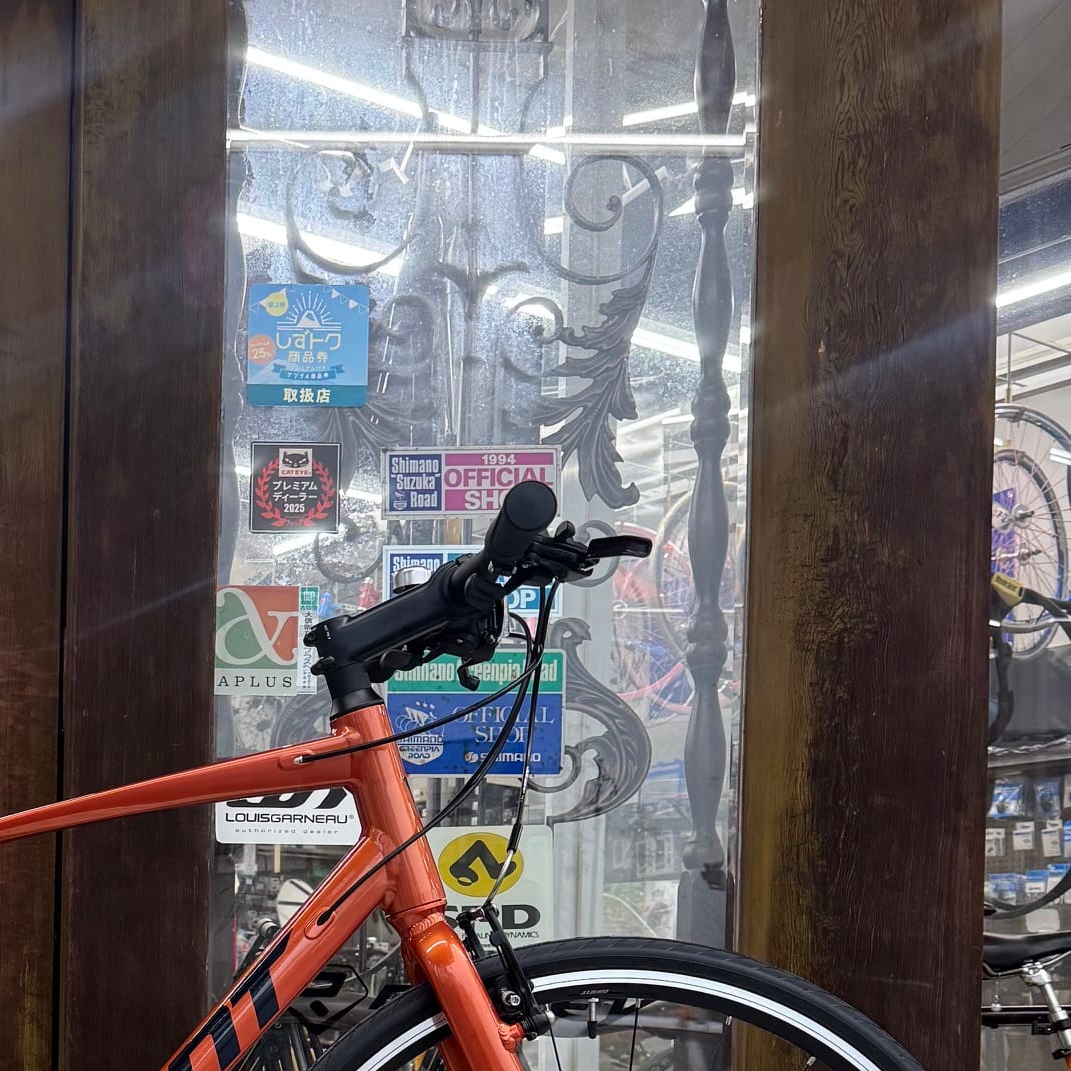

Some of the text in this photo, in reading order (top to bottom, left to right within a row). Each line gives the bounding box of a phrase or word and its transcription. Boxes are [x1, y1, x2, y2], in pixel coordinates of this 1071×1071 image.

[276, 329, 341, 350] しずトク
[289, 351, 328, 363] 商品券
[283, 388, 330, 403] 取扱店
[392, 457, 439, 474] Shimano
[482, 454, 516, 465] 1994
[444, 467, 553, 488] OFFICIAL
[272, 480, 318, 491] プレミアム
[272, 491, 318, 502] ディーラー
[411, 491, 437, 508] Road
[465, 490, 507, 510] SH
[284, 503, 305, 512] 2025
[508, 589, 536, 609] OP
[217, 675, 292, 688] APLUS
[225, 812, 348, 824] LOUISGARNEAU
